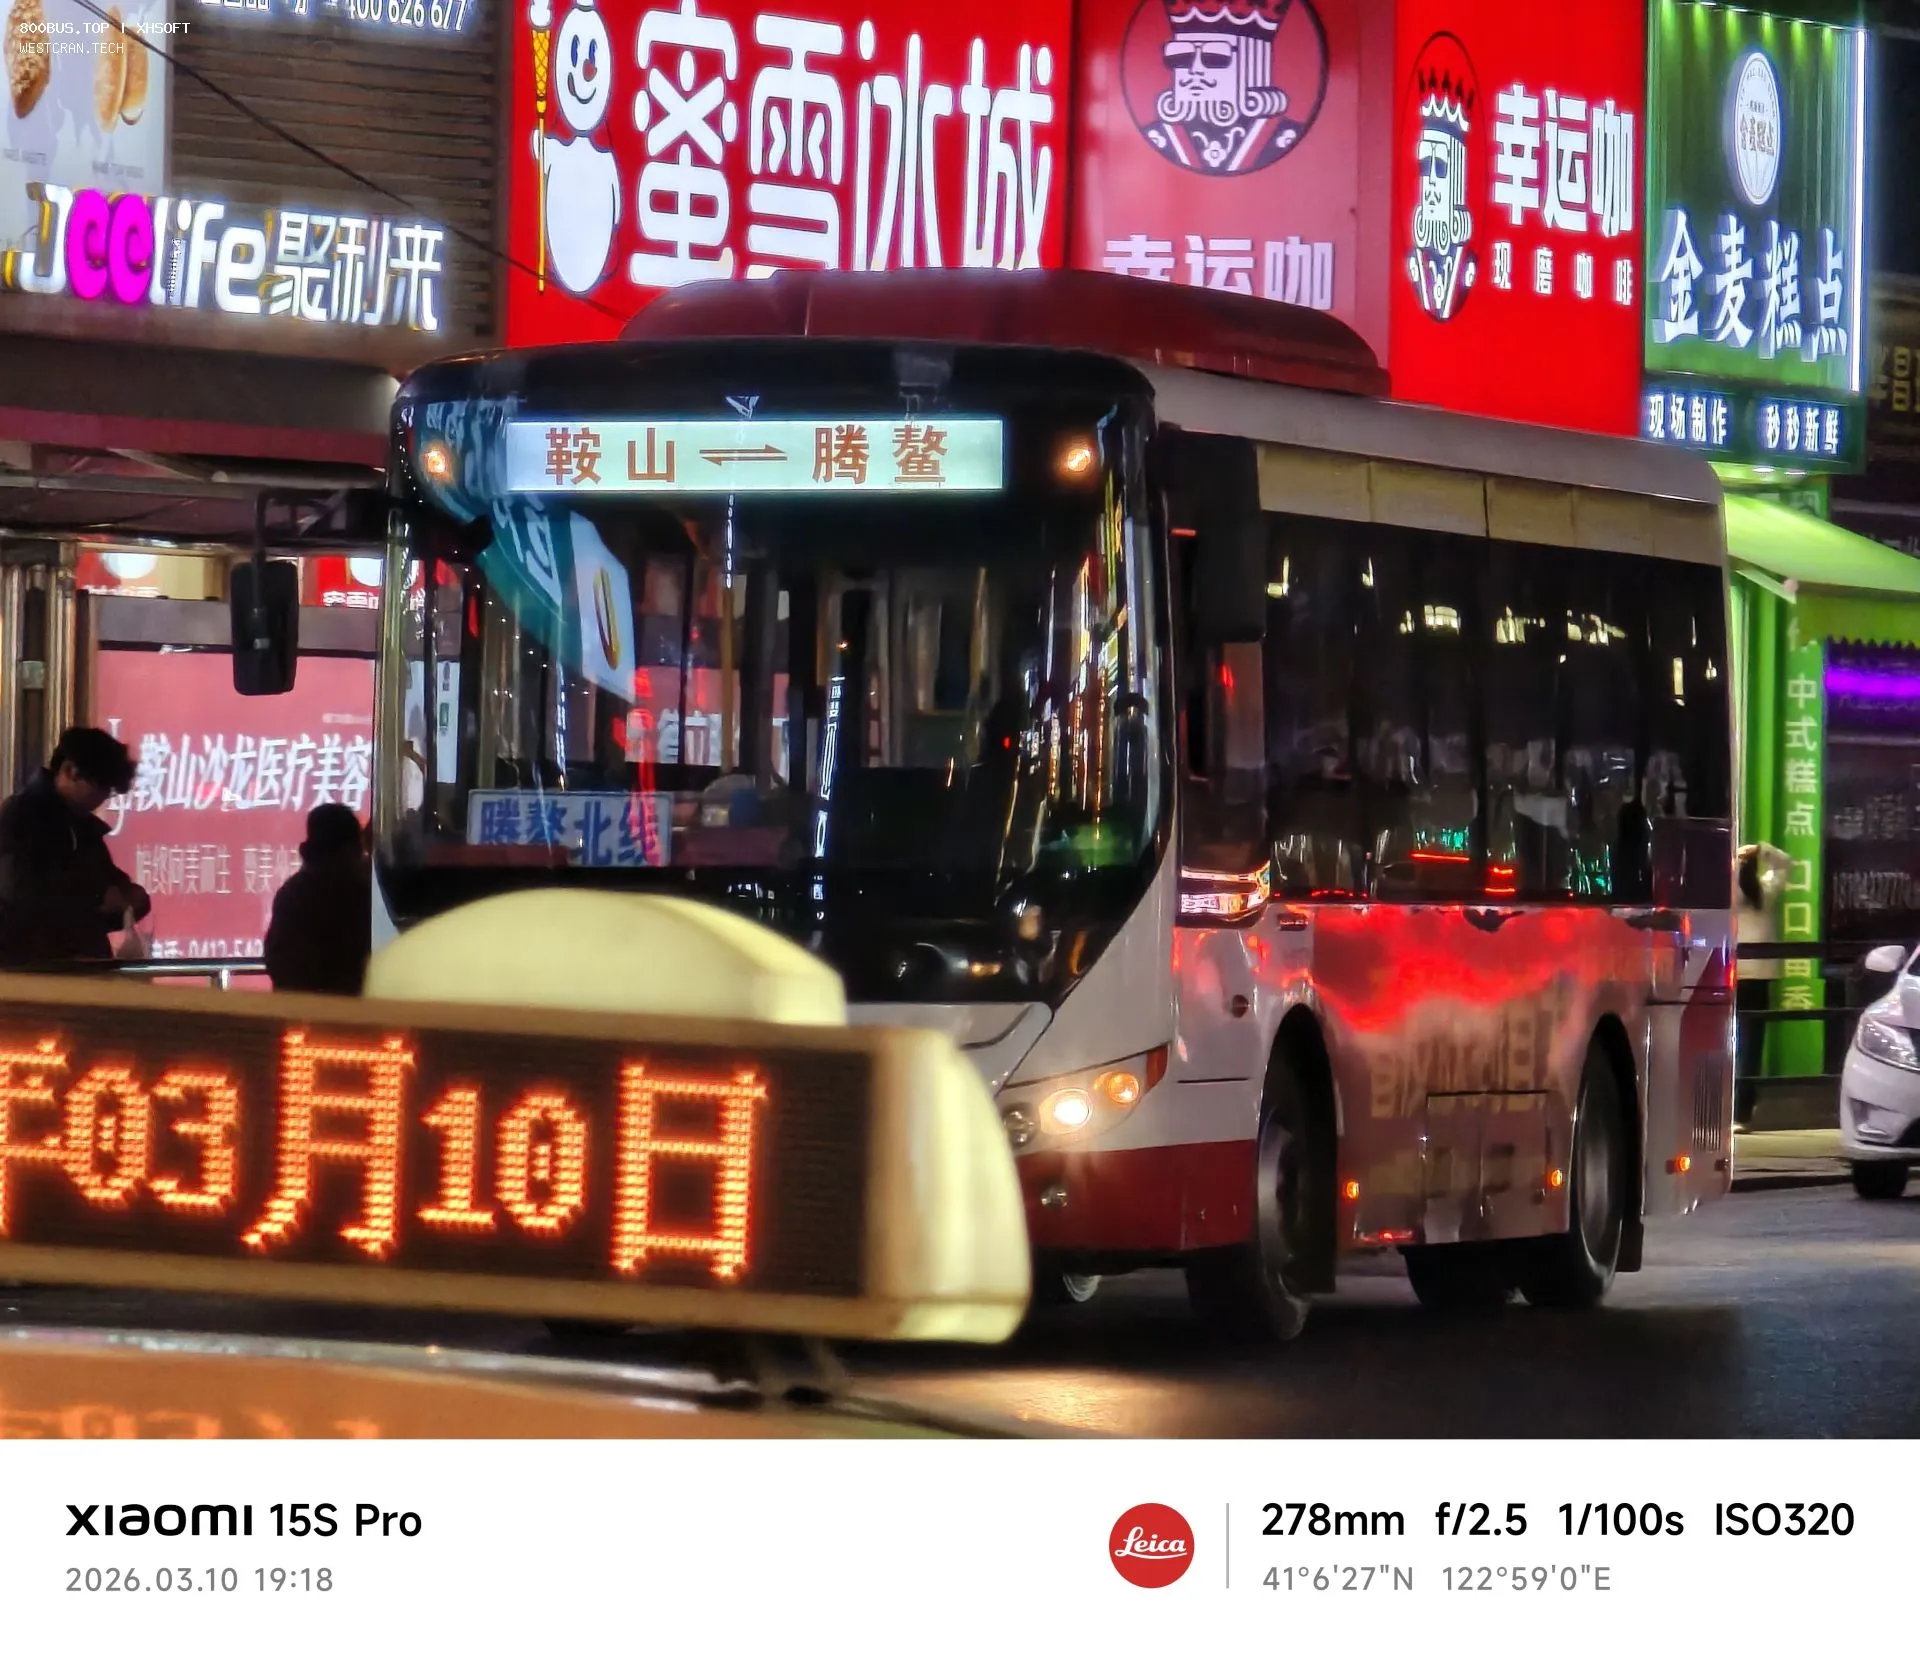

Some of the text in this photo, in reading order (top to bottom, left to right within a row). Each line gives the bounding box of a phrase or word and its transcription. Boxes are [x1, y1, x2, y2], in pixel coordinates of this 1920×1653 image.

[629, 0, 1054, 287] 蜜雪冰城
[1494, 83, 1634, 238] 幸运咖
[267, 210, 444, 332] 聚利来
[1493, 241, 1633, 306] 现磨咖啡
[1656, 208, 1848, 361] 金麦糕点
[545, 426, 947, 486] 鞍山 腾鳌
[1649, 394, 1840, 455] 现场制作 秒秒新鲜
[136, 733, 372, 812] 鞍山沙龙医疗美容
[1785, 673, 1818, 837] 中式糕点
